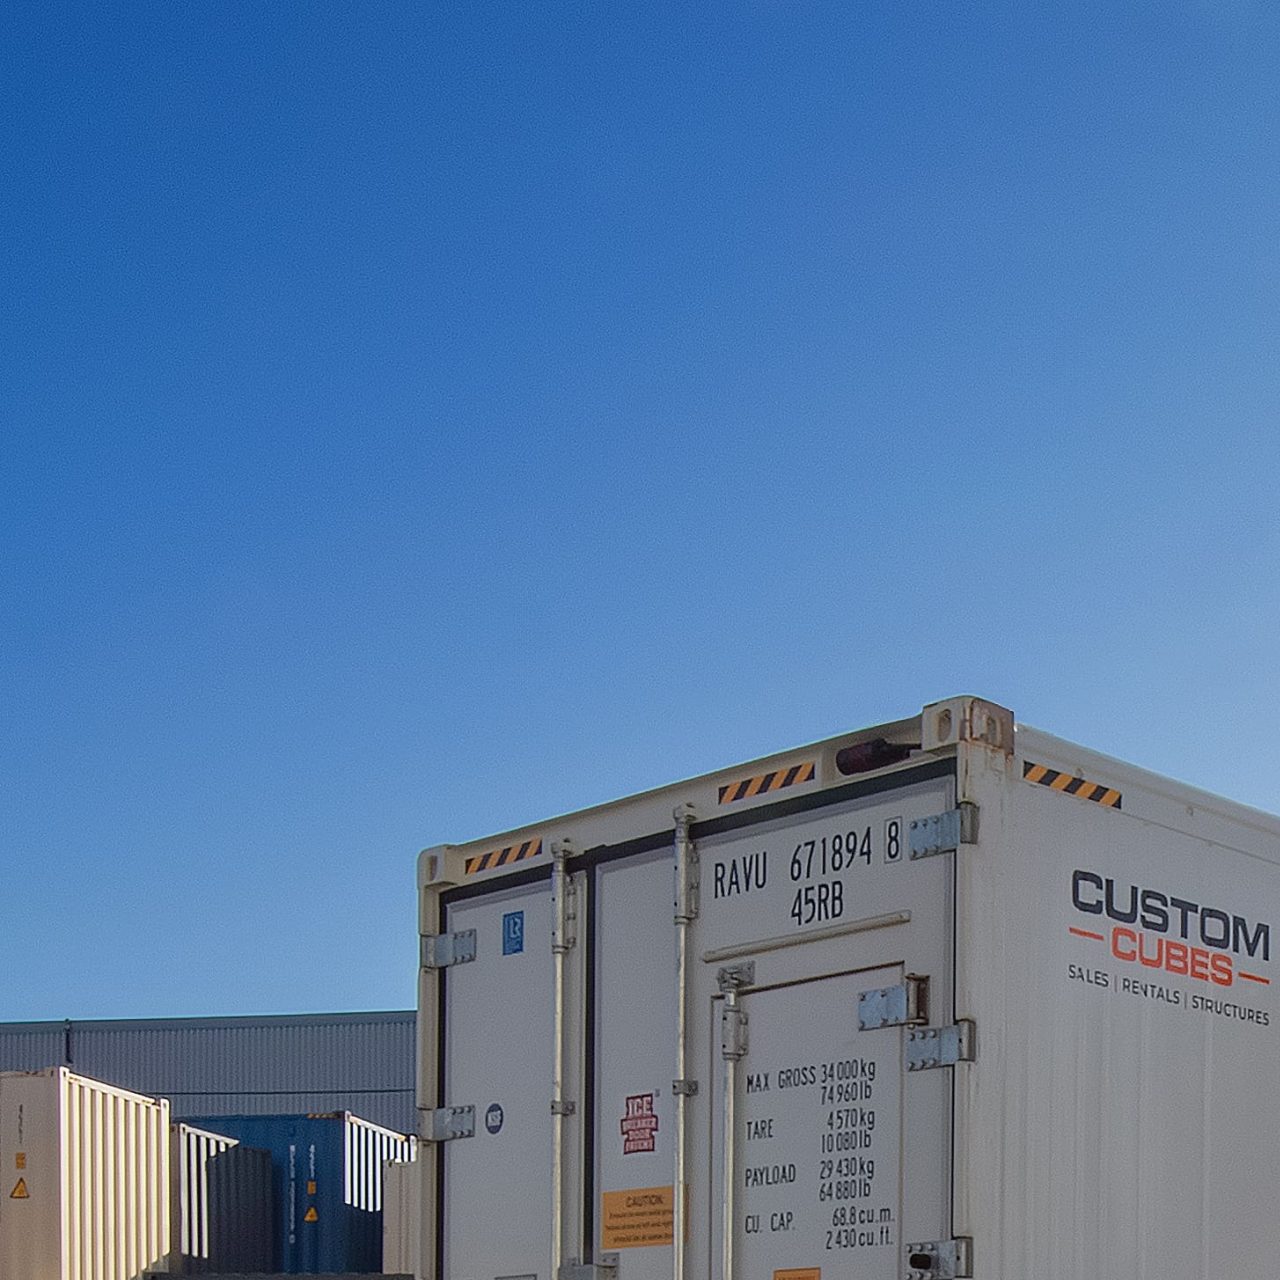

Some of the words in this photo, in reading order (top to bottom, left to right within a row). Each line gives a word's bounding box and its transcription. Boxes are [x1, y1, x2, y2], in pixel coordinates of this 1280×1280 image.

[713, 851, 767, 899] RAVU
[790, 825, 873, 882] 671894
[887, 820, 901, 860] 8
[790, 880, 844, 926] 45RB
[1071, 868, 1270, 961] CUSTOM
[1111, 926, 1233, 987] CUBES
[1068, 964, 1109, 988] SALES
[1122, 977, 1180, 1005] RENTALS
[1192, 995, 1270, 1026] STRUCTURES
[746, 1072, 770, 1094] MAX
[778, 1065, 816, 1089] GROSS
[746, 1118, 774, 1141] TARE
[745, 1163, 796, 1188] PAYLOAD
[745, 1215, 763, 1234] CU.
[770, 1211, 796, 1232] CAP.
